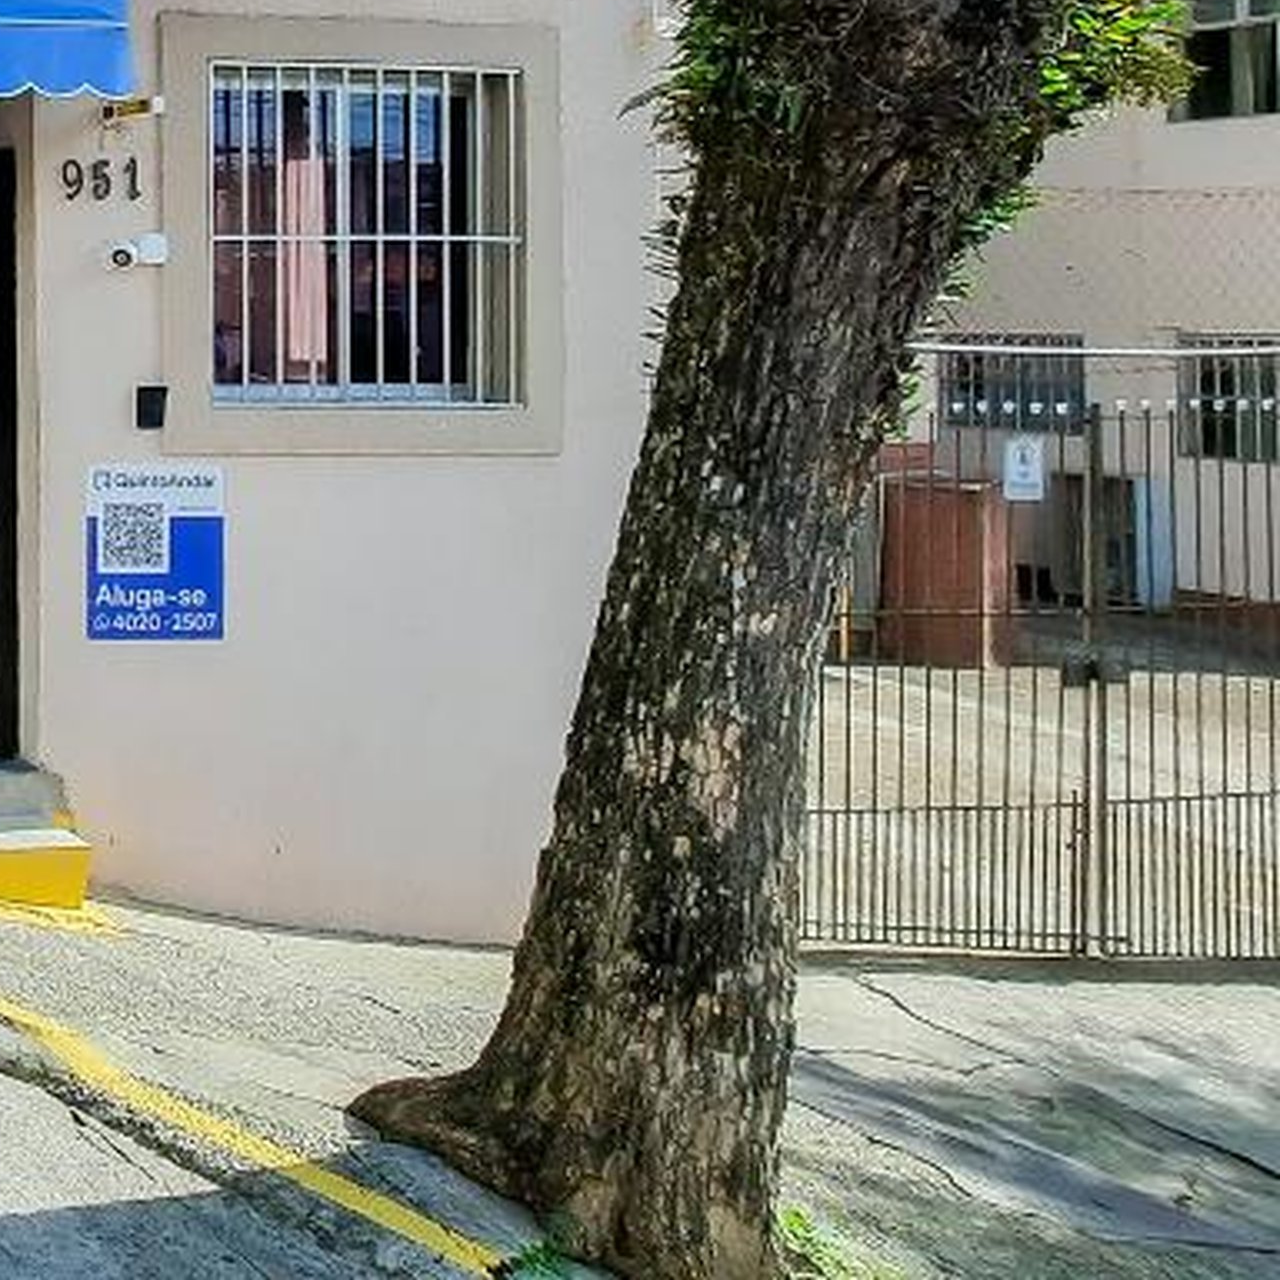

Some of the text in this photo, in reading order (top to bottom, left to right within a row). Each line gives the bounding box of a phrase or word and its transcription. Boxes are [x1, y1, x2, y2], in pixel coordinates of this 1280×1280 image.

[62, 157, 142, 200] 951
[116, 472, 216, 488] QuintoAndar
[96, 583, 208, 611] Aluga-se
